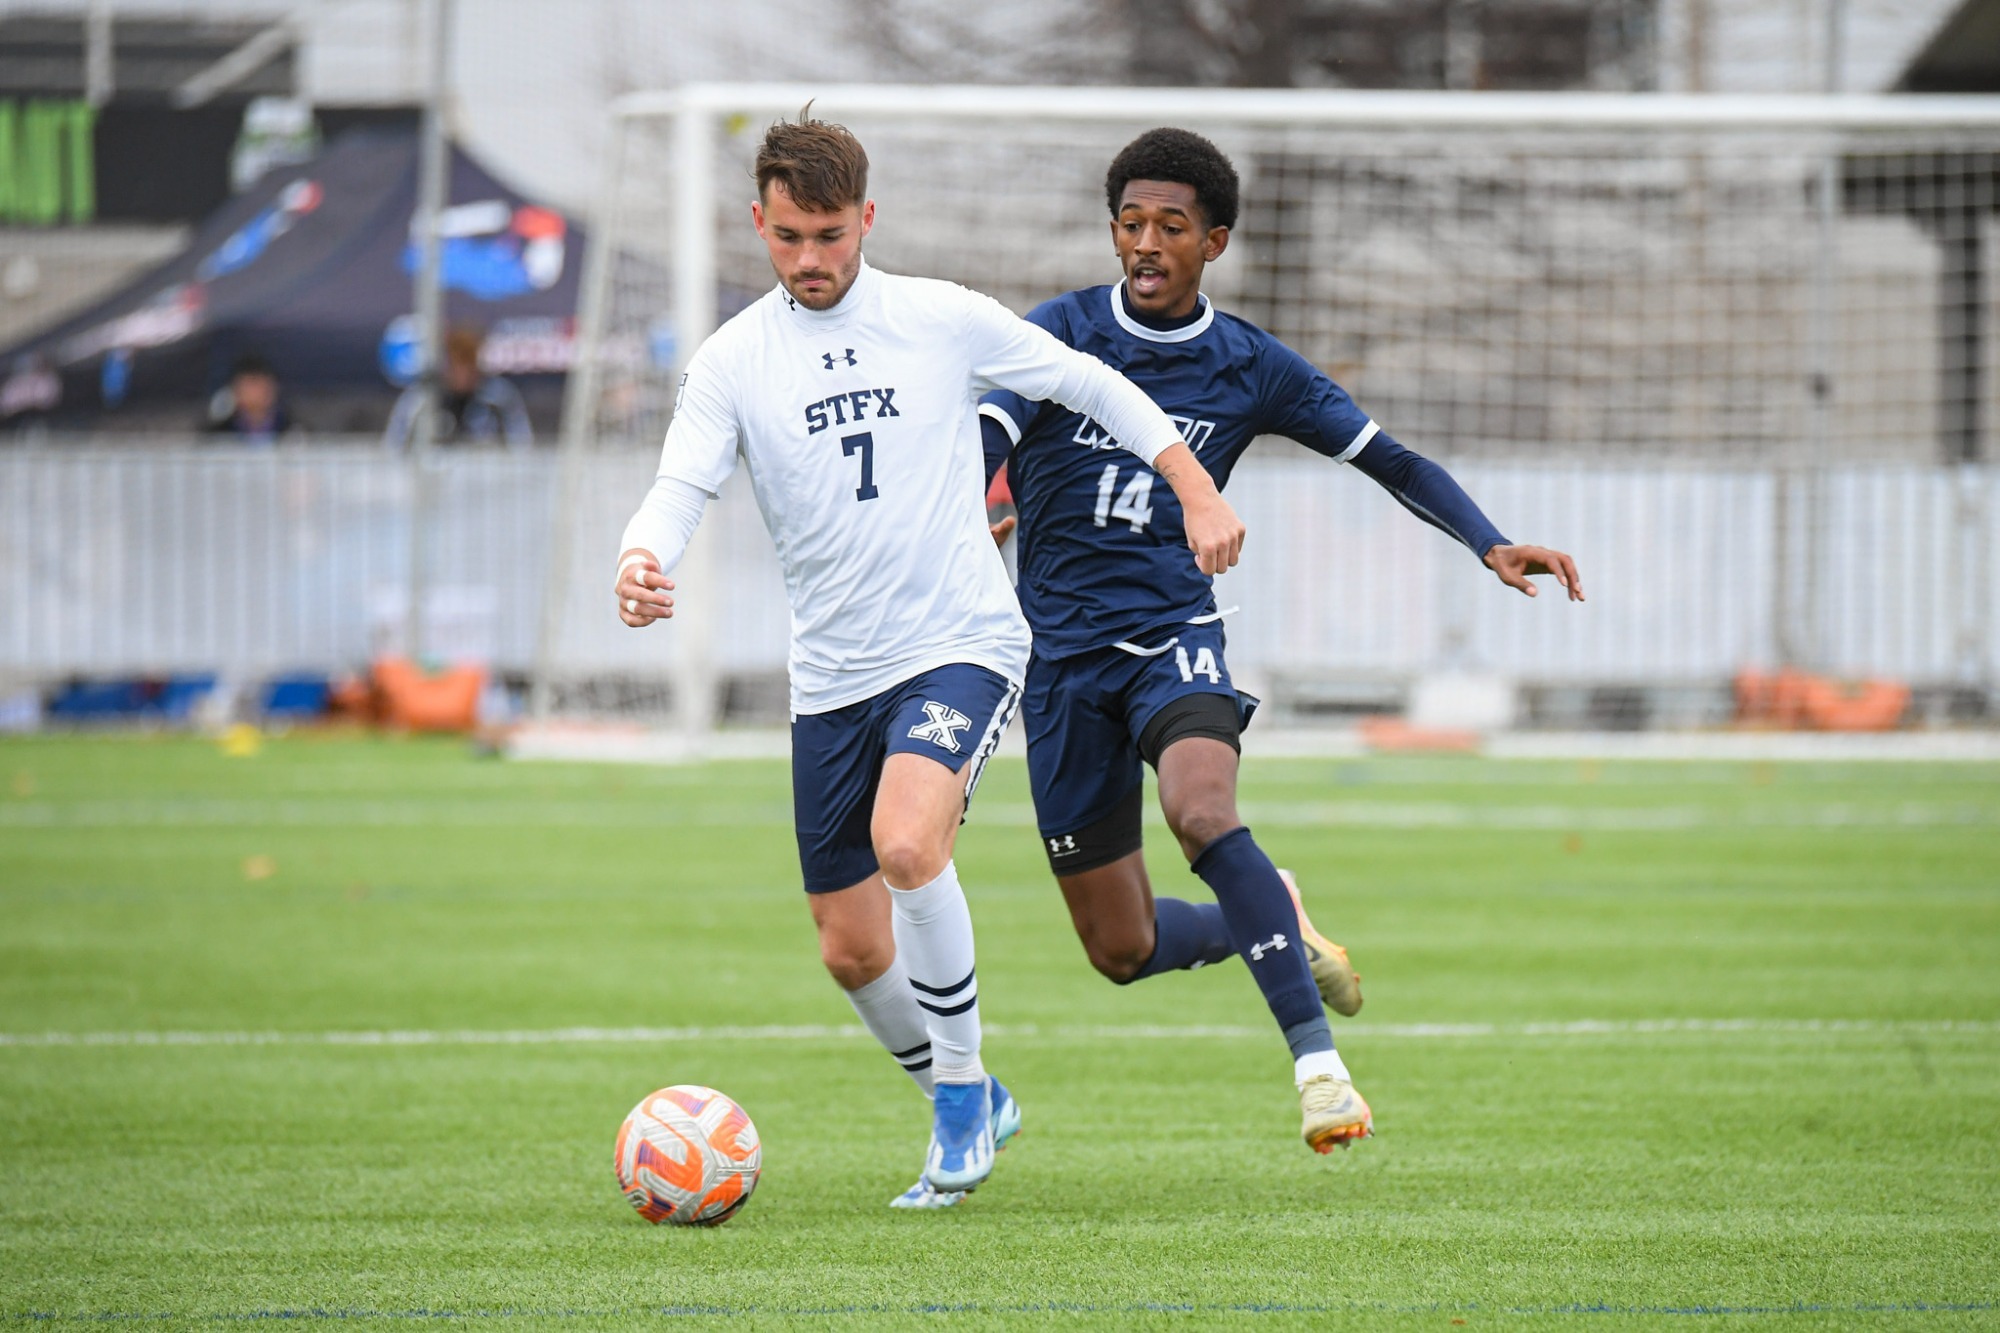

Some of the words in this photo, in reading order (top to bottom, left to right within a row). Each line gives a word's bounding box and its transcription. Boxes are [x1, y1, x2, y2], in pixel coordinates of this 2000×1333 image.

[805, 388, 900, 435] STFX
[841, 431, 879, 502] 7
[1094, 464, 1154, 534] 14
[1175, 646, 1222, 684] 14
[907, 701, 972, 753] X
